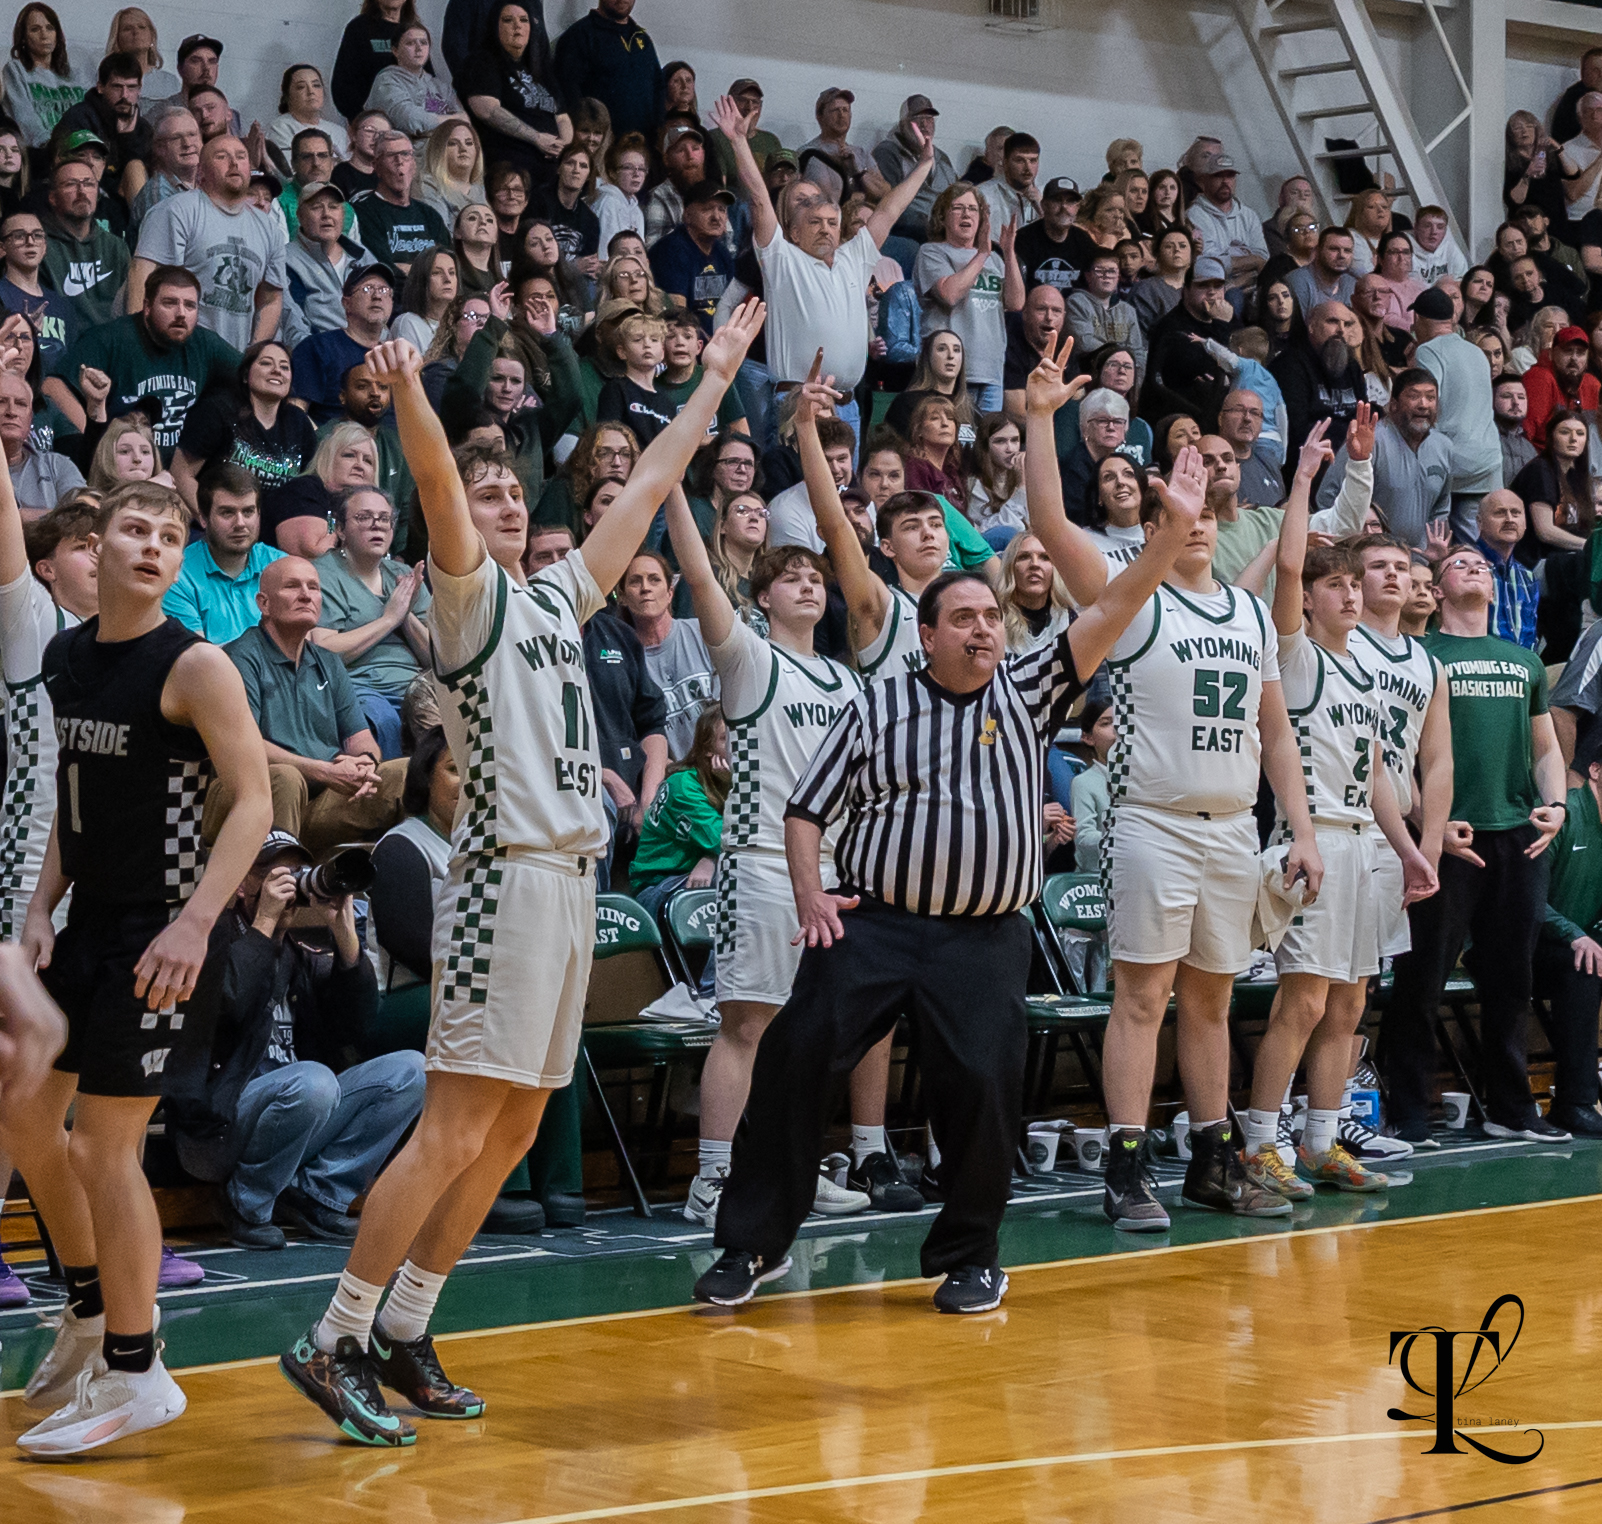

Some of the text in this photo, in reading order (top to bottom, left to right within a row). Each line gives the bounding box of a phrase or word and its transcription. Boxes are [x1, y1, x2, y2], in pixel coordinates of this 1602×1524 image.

[516, 633, 586, 672] WYOM
[1170, 637, 1261, 672] WYOMING
[1444, 660, 1529, 682] WYOMING EAST
[1192, 668, 1248, 722] 52
[1375, 668, 1428, 713] OMING
[1451, 680, 1525, 699] BASKETBALL
[561, 681, 591, 752] 11
[1191, 725, 1244, 754] EAST
[1353, 736, 1370, 783] 2
[67, 762, 82, 833] 1
